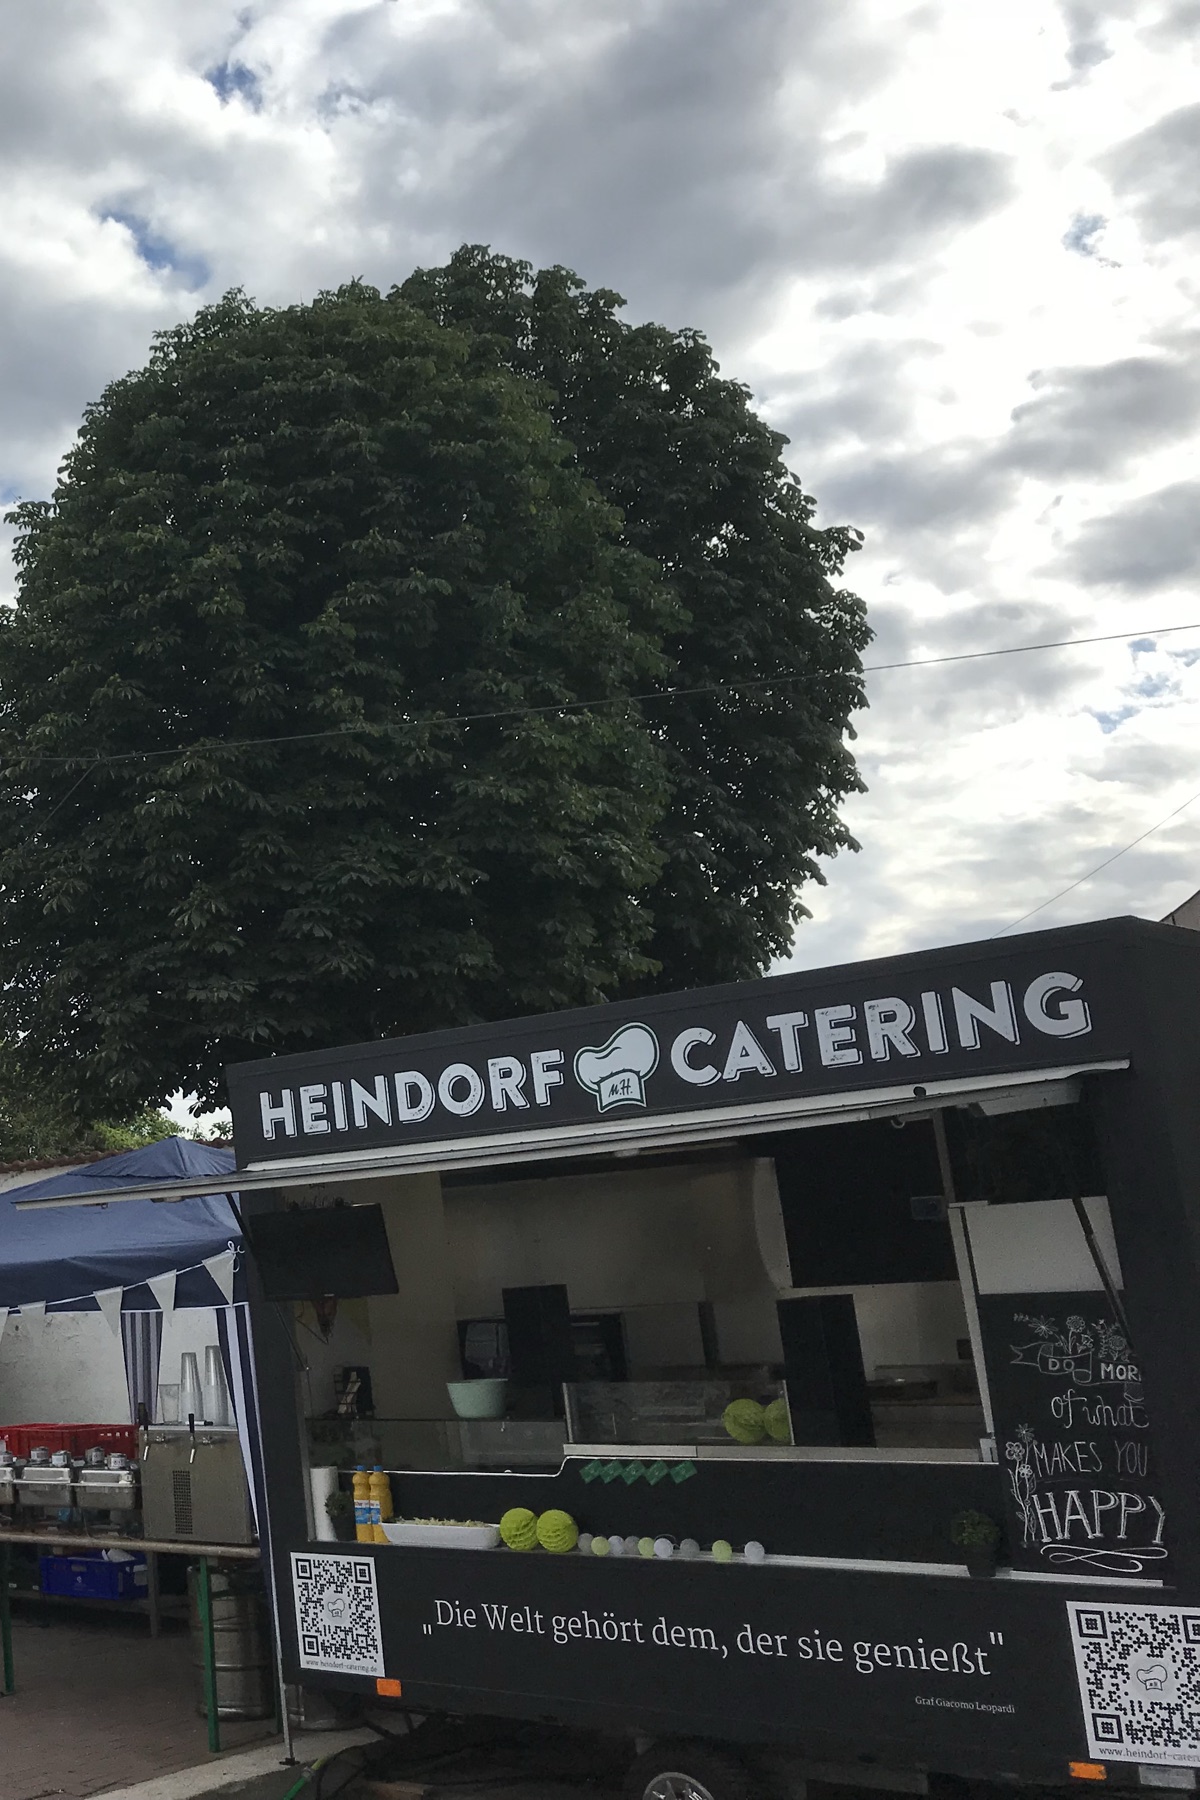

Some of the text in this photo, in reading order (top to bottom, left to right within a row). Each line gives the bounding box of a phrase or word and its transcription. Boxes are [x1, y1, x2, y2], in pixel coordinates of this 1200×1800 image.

[260, 971, 1092, 1140] HEINDORF CATERING
[1048, 1357, 1142, 1382] DO MOR
[1033, 1440, 1148, 1478] MAKES YOU
[481, 1603, 545, 1634] Welt
[552, 1611, 645, 1644] gehört
[651, 1617, 728, 1659] dem,
[736, 1624, 788, 1657] der
[798, 1629, 844, 1662] sie
[915, 1696, 1016, 1714] Graf Giacomo Leopardi
